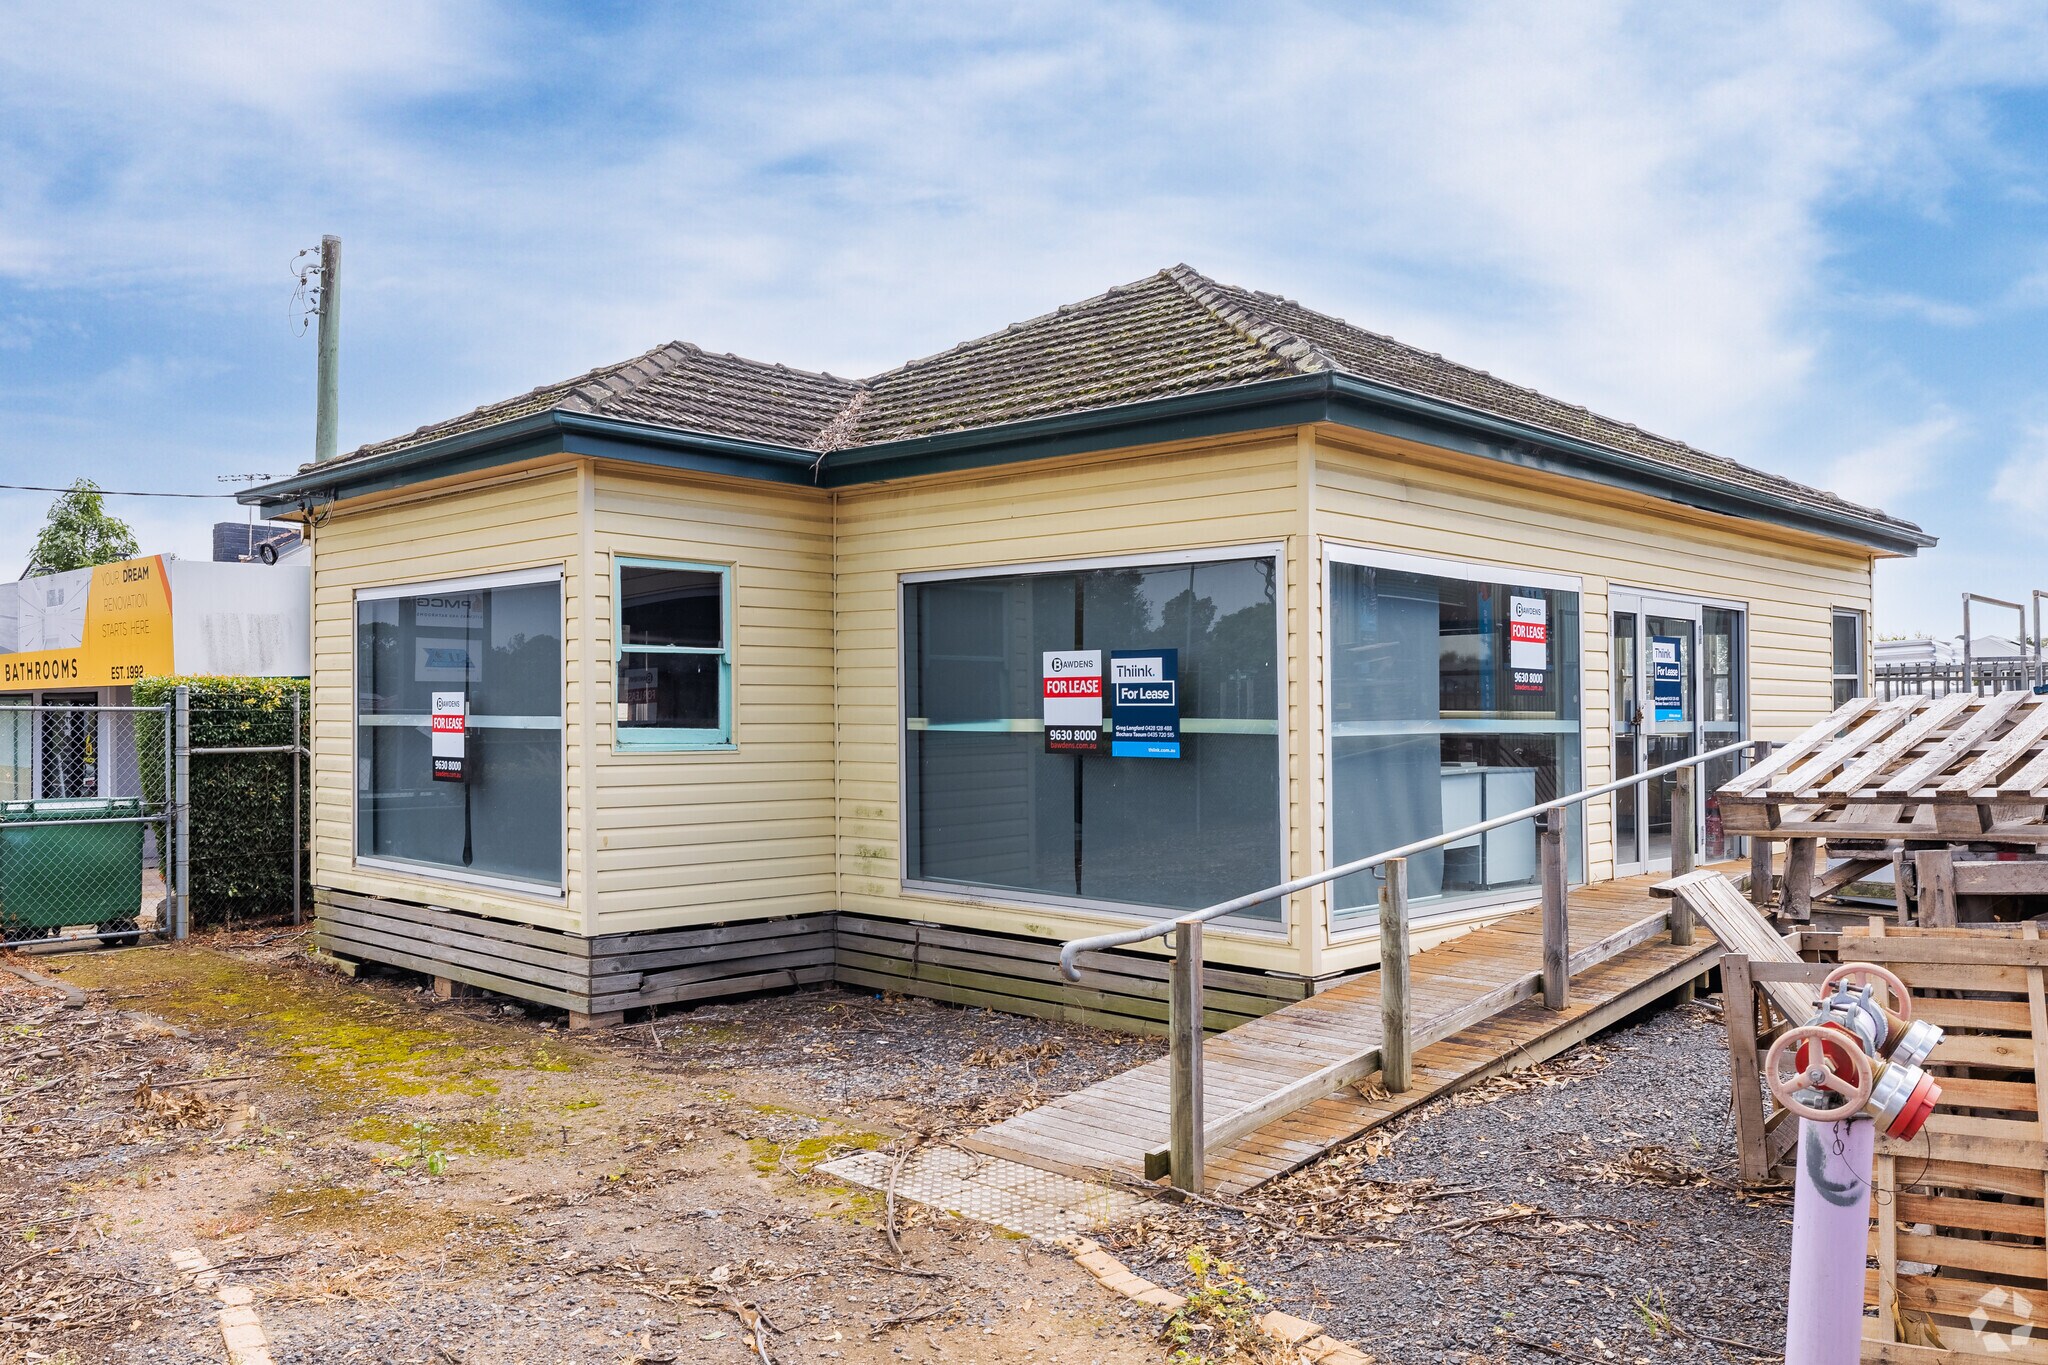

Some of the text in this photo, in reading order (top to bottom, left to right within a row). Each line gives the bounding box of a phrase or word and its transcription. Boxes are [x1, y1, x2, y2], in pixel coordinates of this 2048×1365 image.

[101, 566, 150, 588] YOUR DREAM
[103, 593, 148, 612] RENOVATION
[1515, 602, 1542, 617] BAWDENS
[102, 620, 128, 638] STARTS
[1512, 625, 1545, 640] FOR LEASE
[4, 658, 78, 683] BATHROOMS
[1052, 657, 1094, 672] BAWDENS
[1116, 665, 1156, 678] Thiink.
[1657, 665, 1679, 677] For Lease
[126, 665, 144, 679] 1992
[1514, 672, 1544, 684] 9630 8000
[1047, 679, 1099, 693] FOR LEASE
[1121, 687, 1170, 699] For Lease
[436, 697, 460, 711] BAWDENS
[433, 717, 463, 730] FOR LEASE
[1050, 729, 1097, 741] 9630 8000
[1050, 741, 1097, 749] bawdens.com.au
[435, 760, 462, 771] 9630 8000
